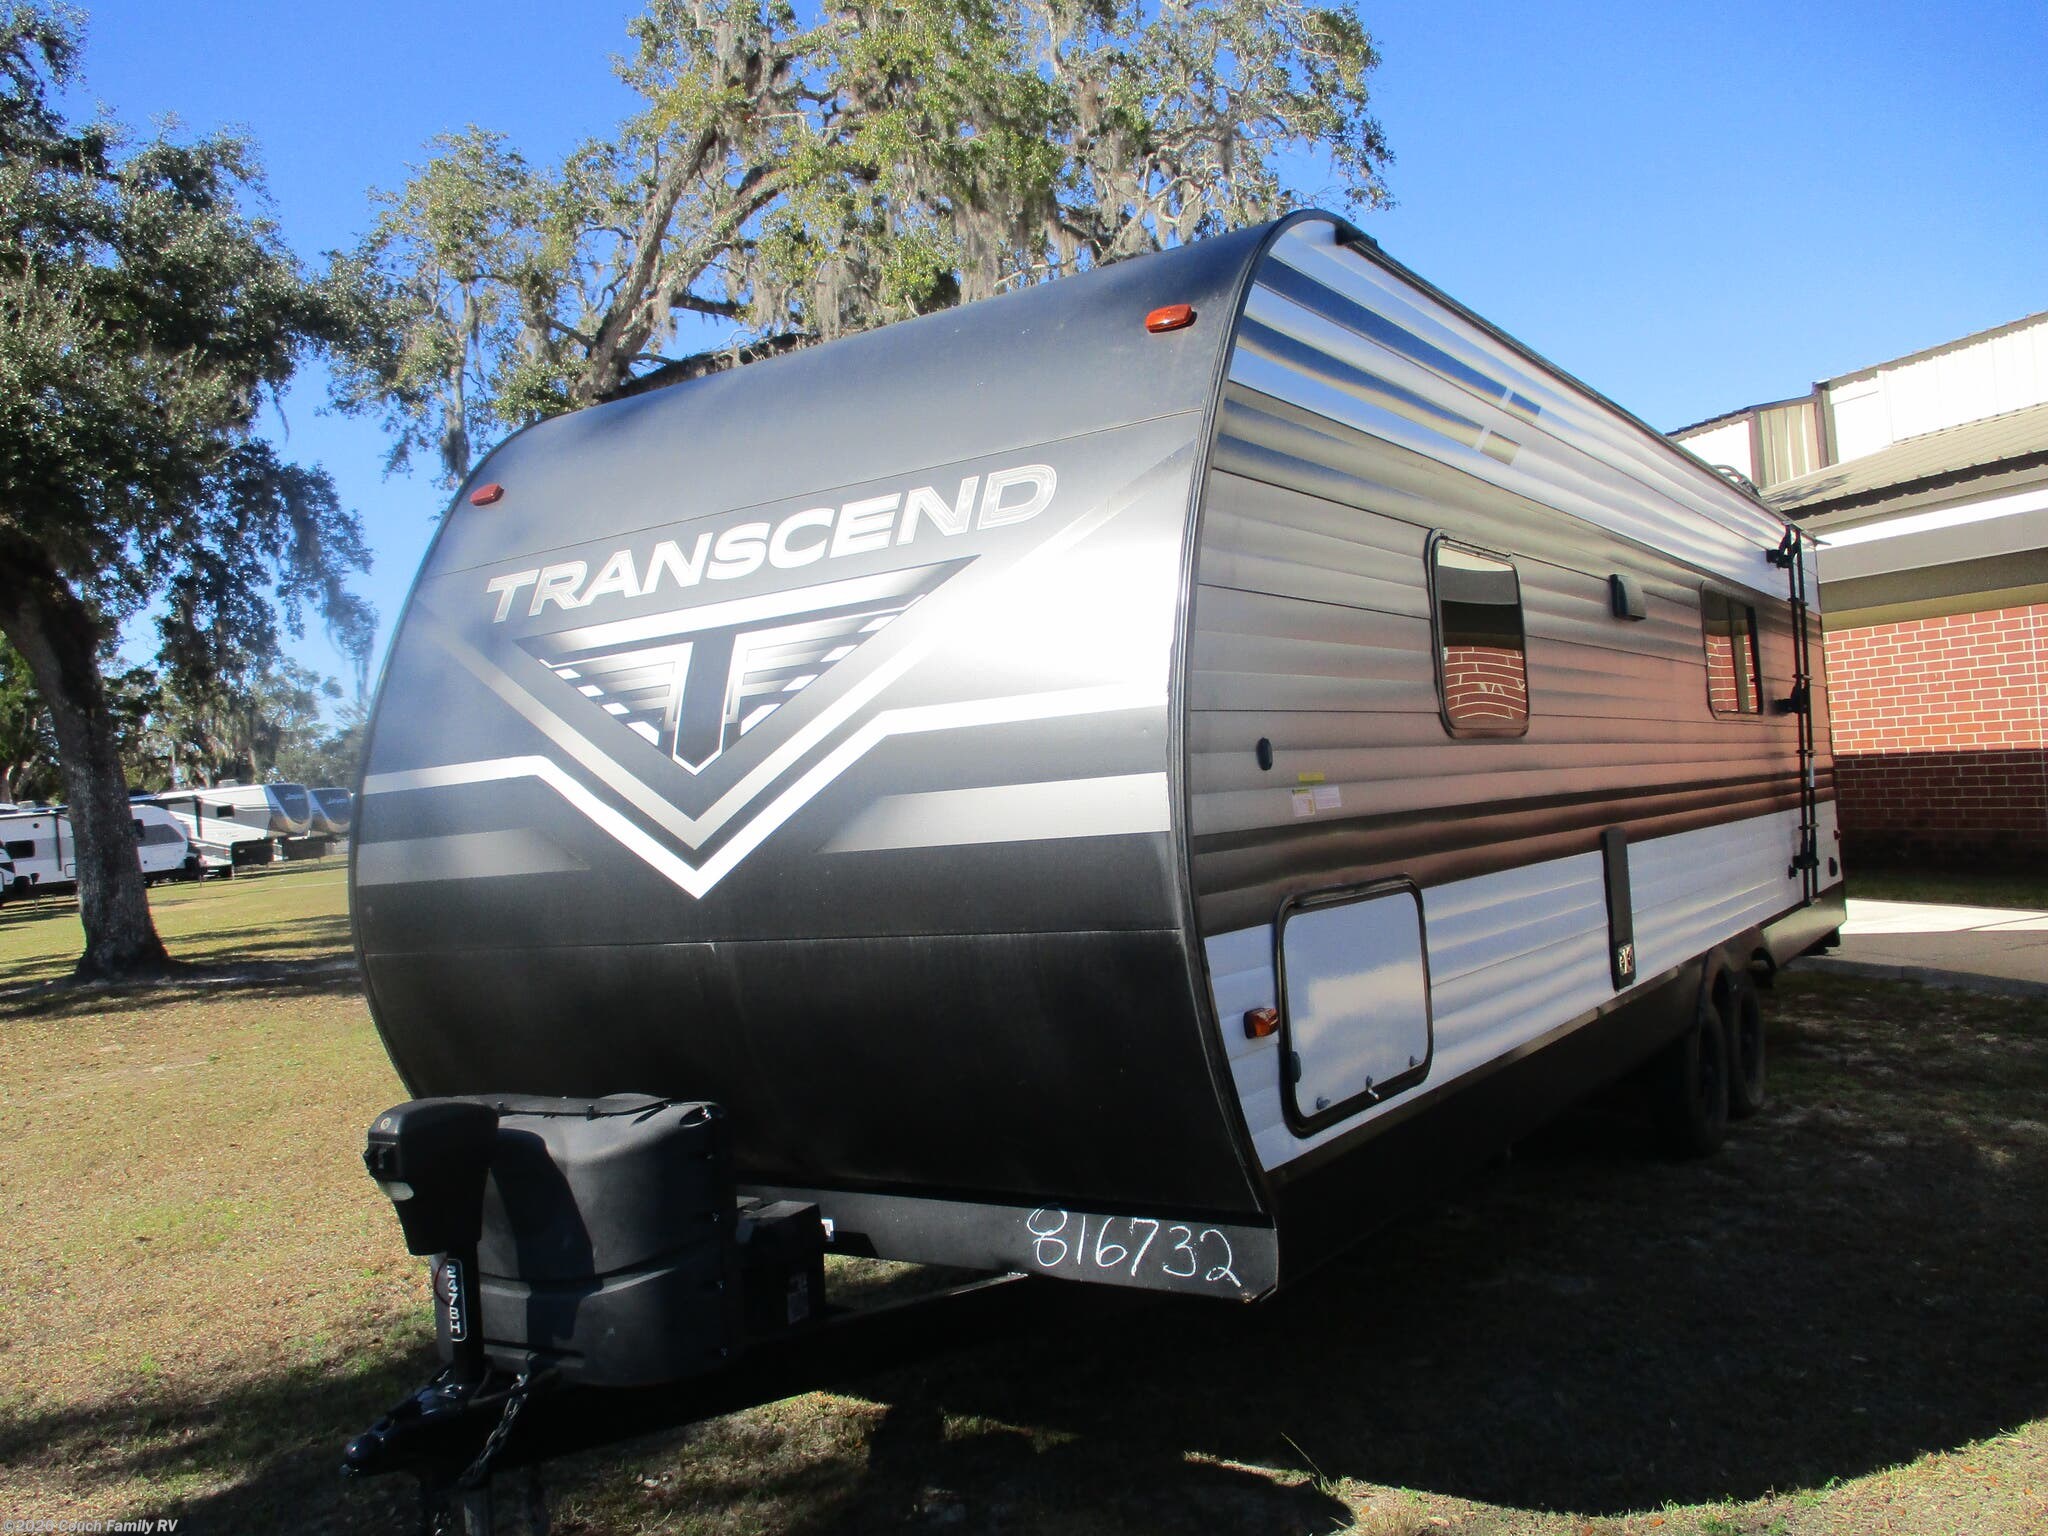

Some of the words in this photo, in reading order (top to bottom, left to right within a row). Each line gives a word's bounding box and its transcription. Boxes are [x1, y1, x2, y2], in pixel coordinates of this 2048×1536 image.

[486, 463, 1058, 623] TRANSCEND
[1026, 1207, 1243, 1288] 816732
[446, 1264, 461, 1334] 247BH
